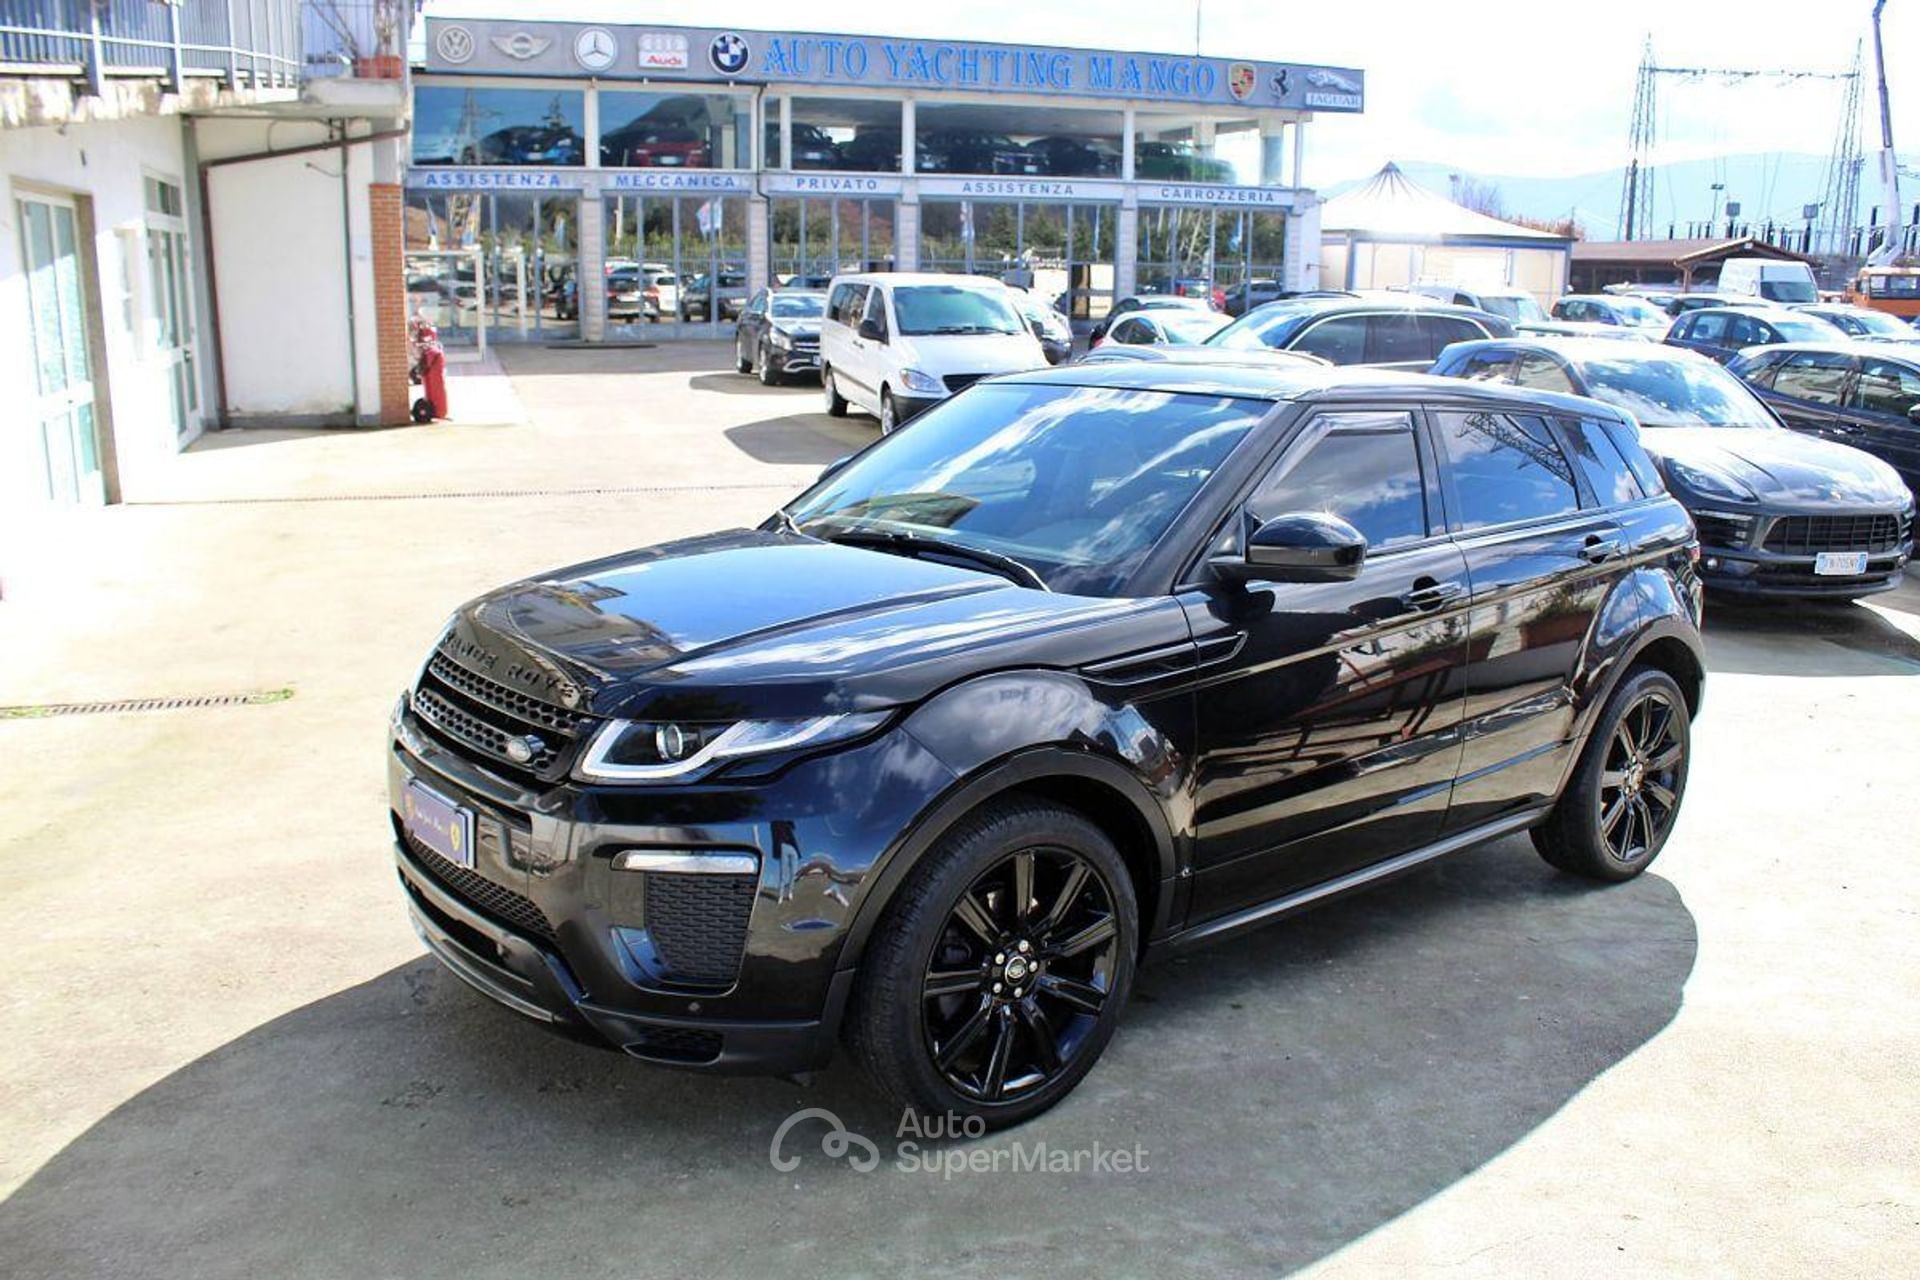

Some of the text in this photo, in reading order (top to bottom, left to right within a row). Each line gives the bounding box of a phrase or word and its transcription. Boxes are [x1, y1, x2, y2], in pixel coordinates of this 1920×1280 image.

[648, 55, 682, 65] Audi
[763, 38, 1216, 95] AUTO YACHTING MANGO
[425, 173, 561, 187] ASSISTENZA
[615, 175, 736, 189] MECCANICA
[796, 177, 878, 191] PRIVATO
[962, 182, 1075, 196] ASSISTENZA
[1161, 187, 1275, 203] CARROZZERIA
